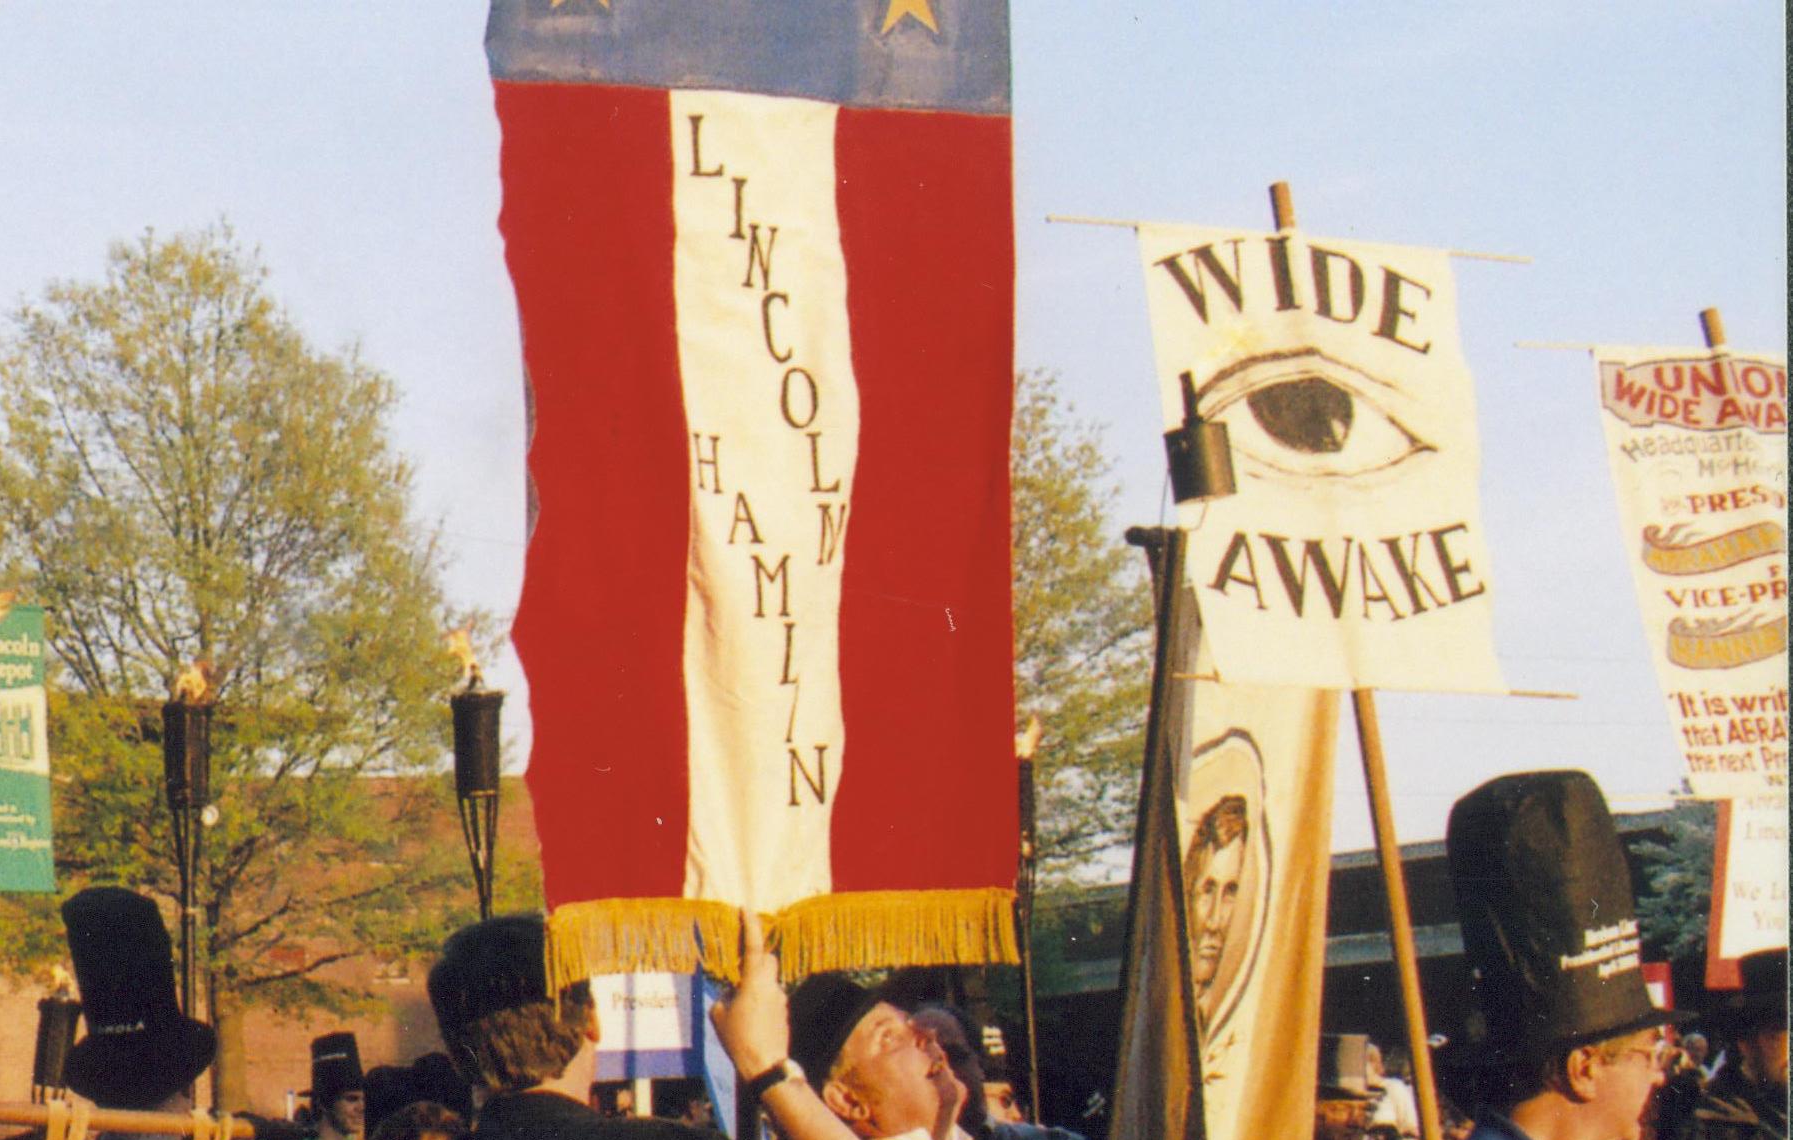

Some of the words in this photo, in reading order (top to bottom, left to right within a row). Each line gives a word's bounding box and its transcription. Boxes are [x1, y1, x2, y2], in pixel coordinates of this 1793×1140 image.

[1153, 236, 1432, 354] WIDE
[687, 114, 847, 566] LINCOLN
[1614, 368, 1702, 425] WIDE
[1207, 522, 1486, 623] AWAKE
[692, 432, 829, 807] HAMLIN
[1682, 722, 1723, 747] that
[1700, 690, 1729, 716] is
[1686, 752, 1717, 773] the
[1718, 750, 1756, 773] next
